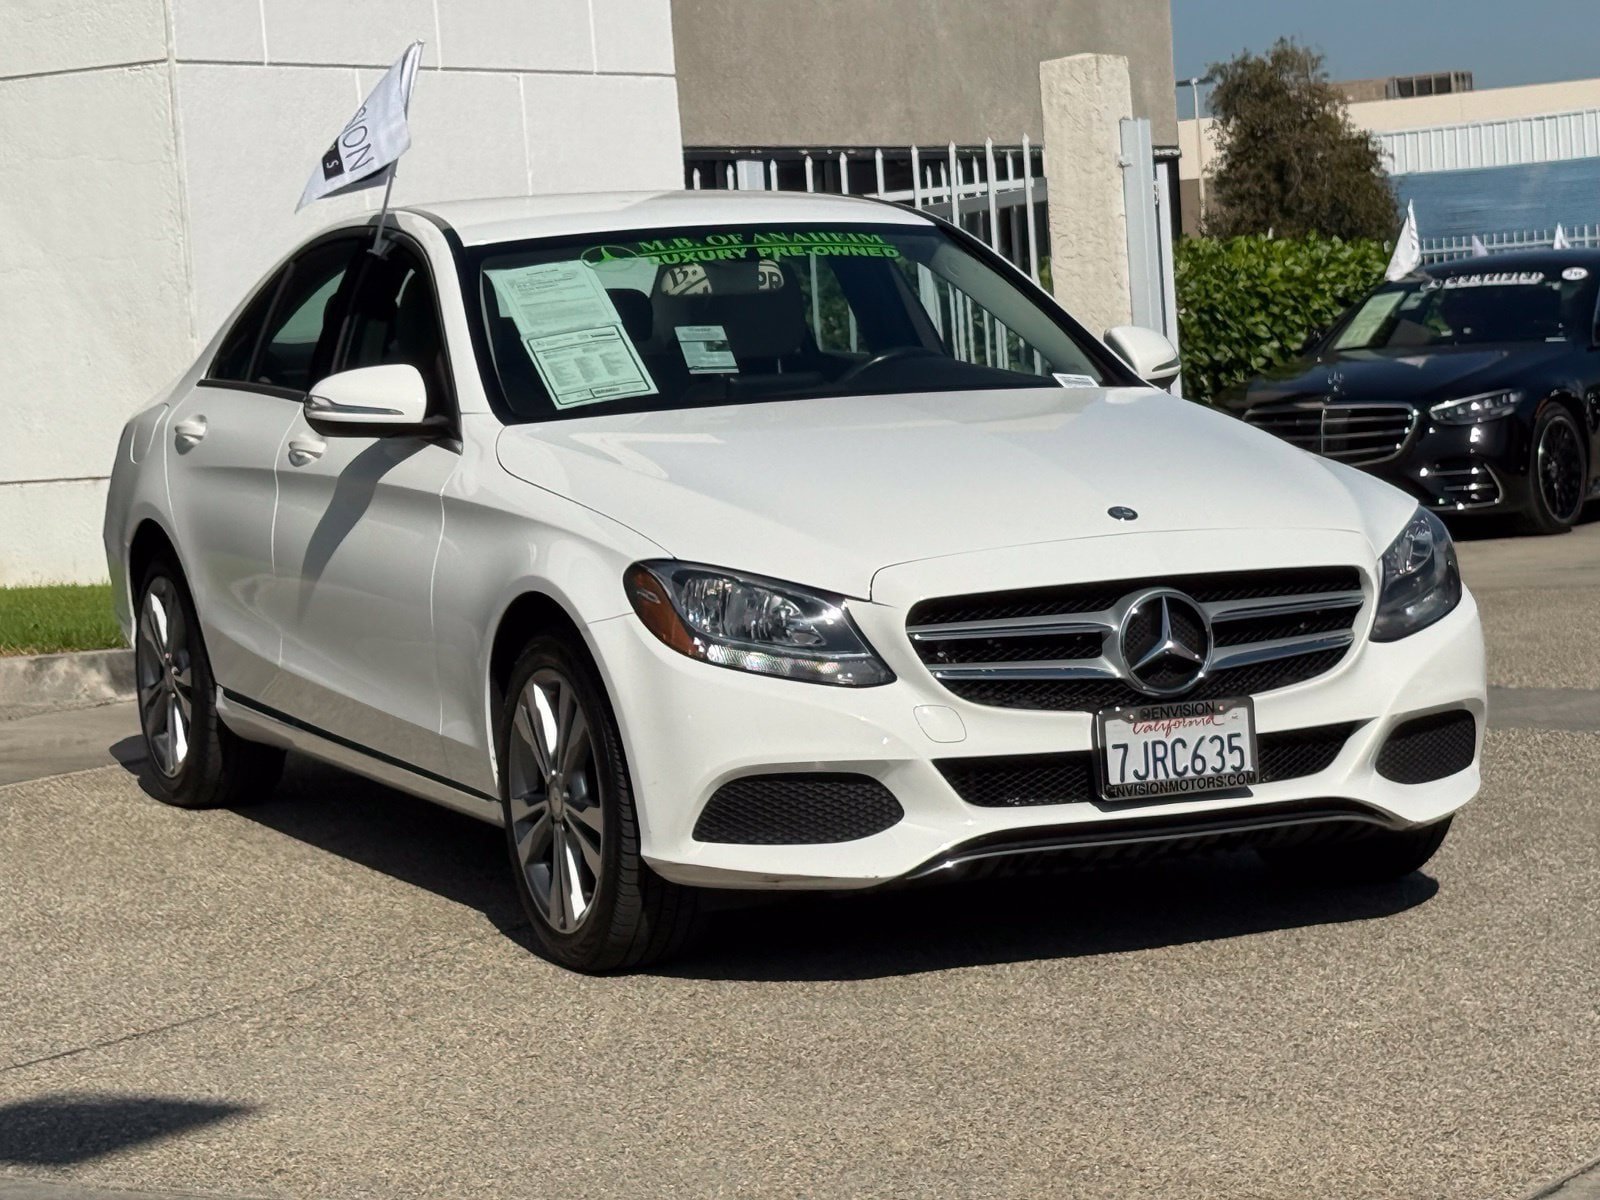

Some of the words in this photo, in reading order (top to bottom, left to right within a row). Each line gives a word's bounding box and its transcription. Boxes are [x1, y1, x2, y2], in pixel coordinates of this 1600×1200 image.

[638, 237, 702, 252] M.B.
[705, 233, 743, 246] OF
[753, 231, 885, 244] ANAHEIM
[756, 245, 900, 258] PRE-OWNED
[1151, 701, 1215, 720] ENVISION
[1132, 715, 1225, 738] California
[1112, 732, 1245, 783] 7JRC635
